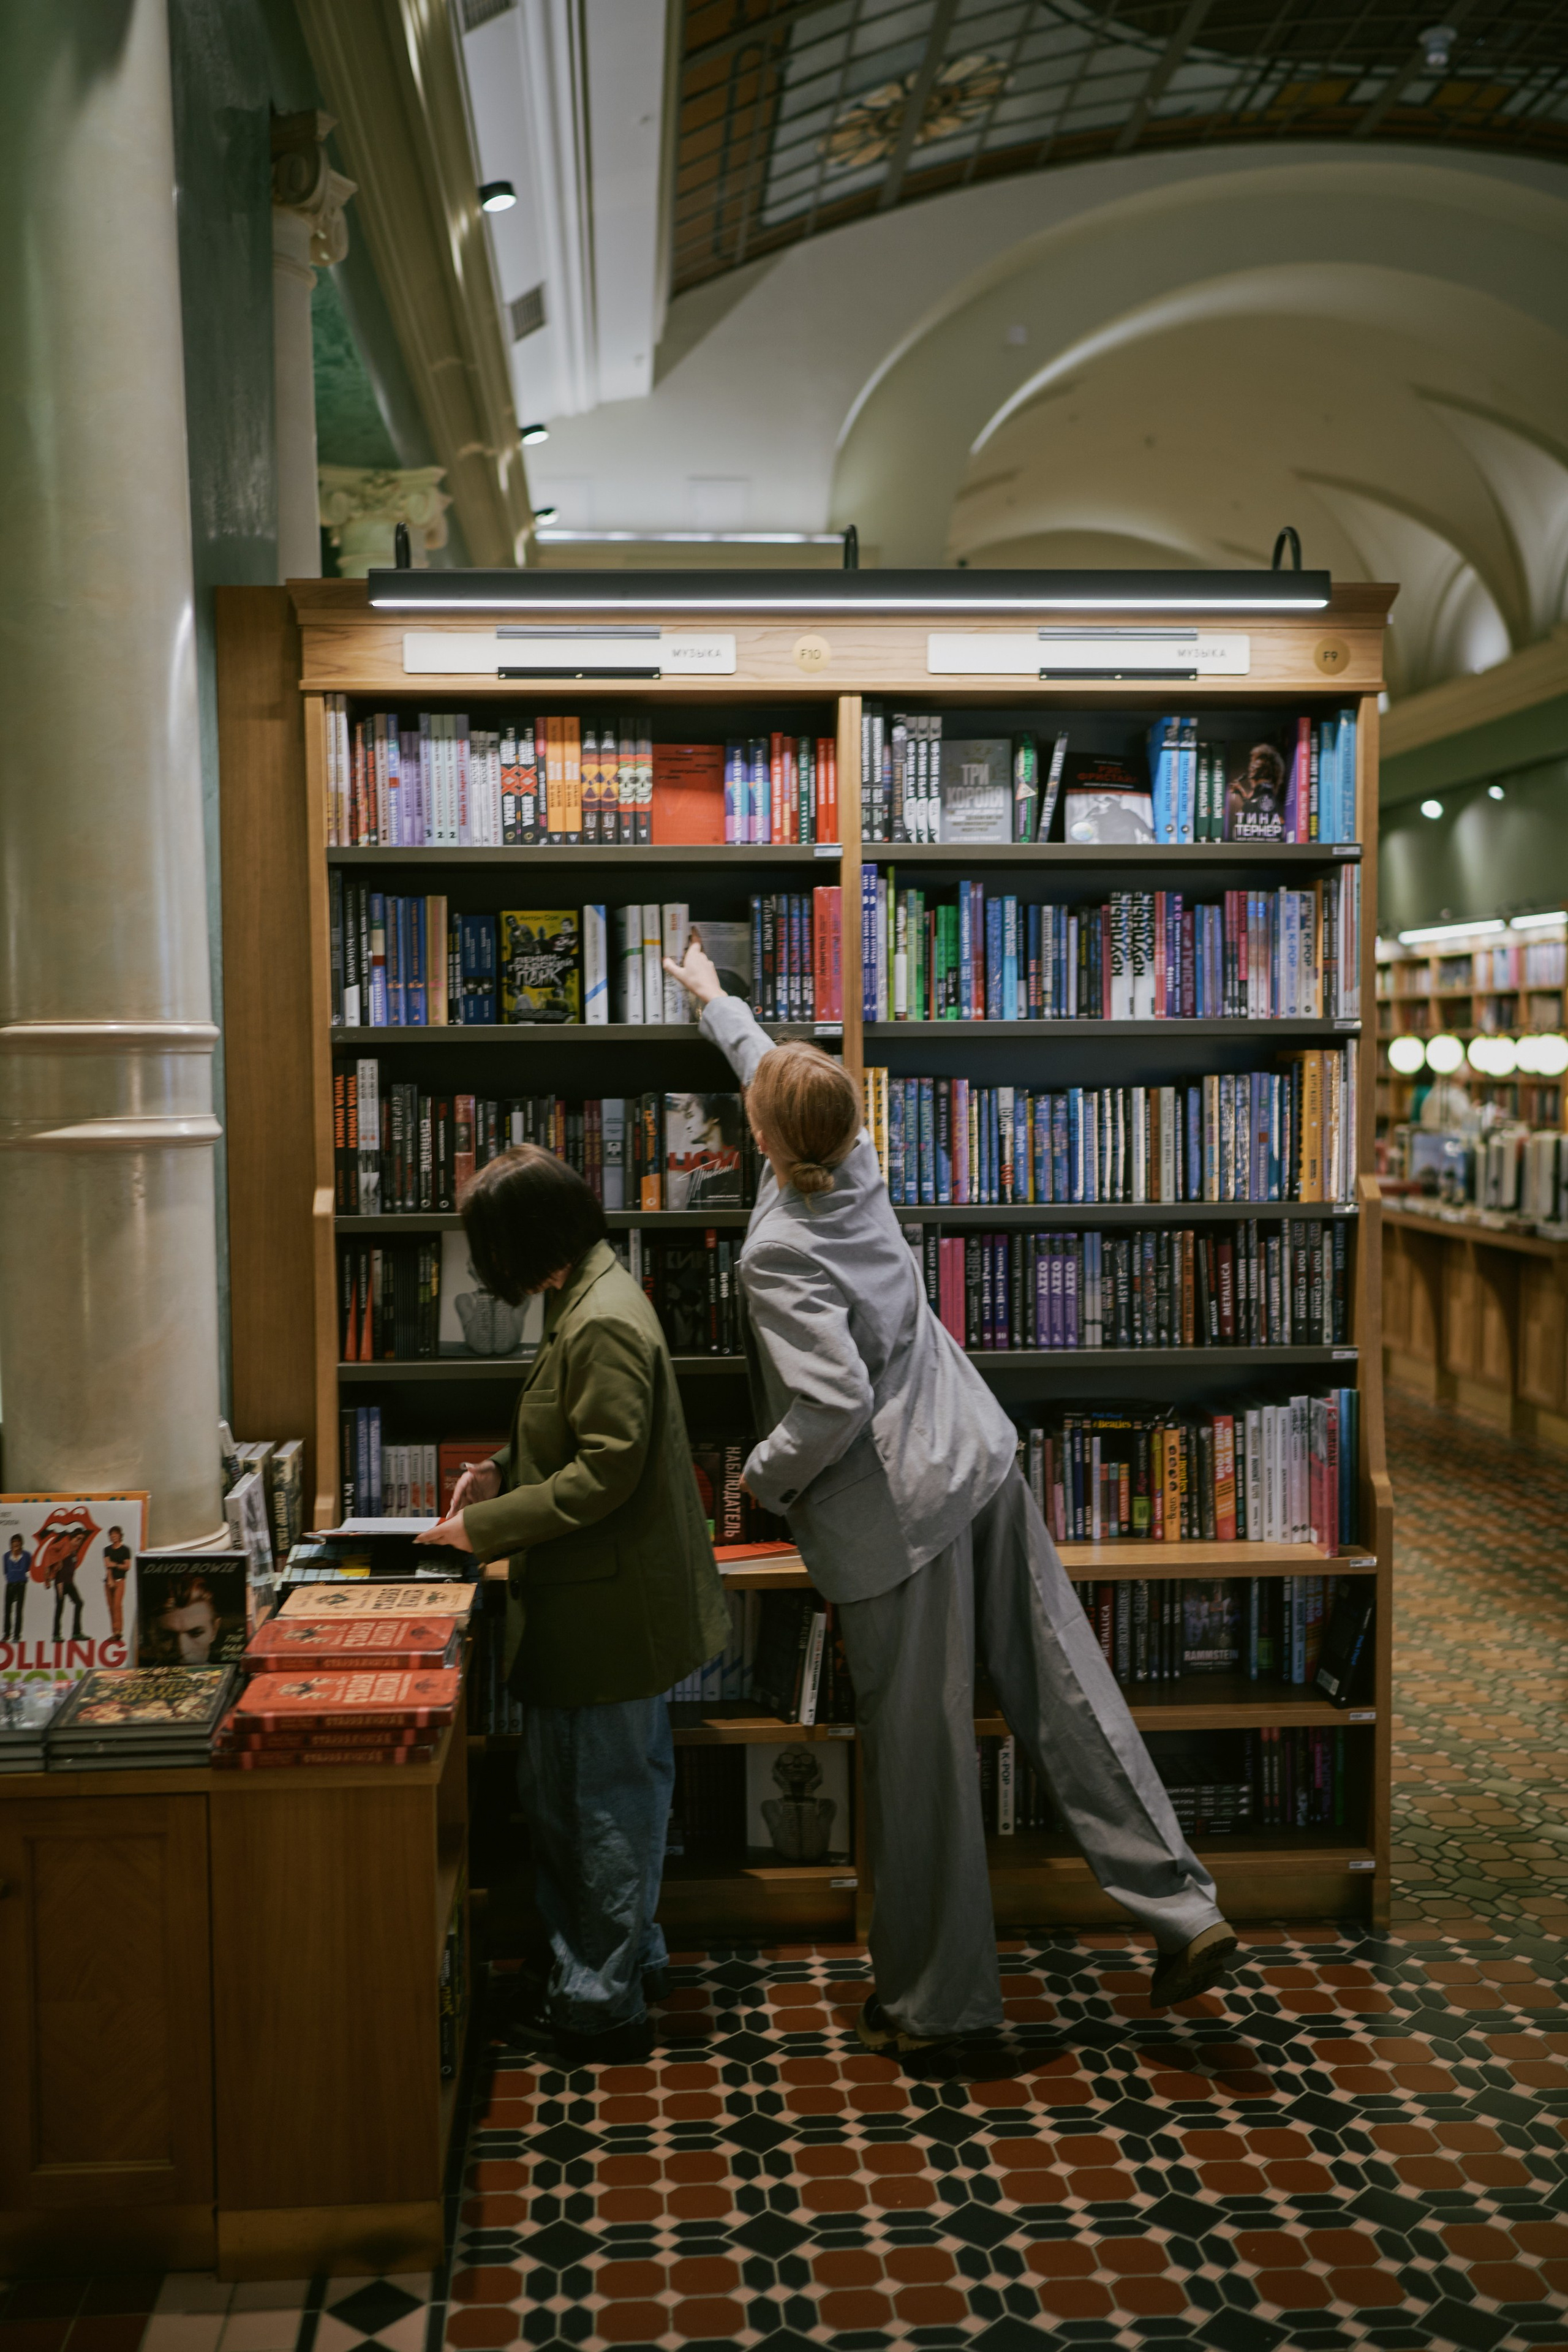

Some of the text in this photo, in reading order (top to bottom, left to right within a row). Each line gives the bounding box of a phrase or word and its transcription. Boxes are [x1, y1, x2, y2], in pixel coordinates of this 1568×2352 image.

[671, 647, 723, 659] МУЗЫКА
[799, 648, 821, 661] F10
[1177, 647, 1227, 659] МУЗЫКА
[1322, 650, 1338, 663] F9
[907, 741, 915, 796] WU-TANG CLAN
[918, 741, 927, 796] WU-TANG CLAN
[930, 741, 939, 796] WU-TANG CLAN
[961, 764, 989, 785] ТРИ
[1050, 752, 1064, 777] KIZARU
[946, 786, 1005, 809] КОРОЛЯ
[1199, 782, 1207, 817] ИСТОРИЯ
[1213, 783, 1222, 818] ИСТОРИЯ
[1234, 824, 1282, 837] ТЕРНЕР
[1235, 812, 1281, 825] ТИНА
[1174, 895, 1182, 920] EXO
[763, 900, 772, 950] АГАТА КРИСТИ
[1111, 892, 1123, 976] КРУПНЫЕ
[1123, 892, 1133, 962] ФОРМЫ
[1133, 892, 1144, 976] КРУПНЫЕ
[1143, 892, 1155, 962] ФОРМЫ
[508, 958, 573, 972] ГРАДСКИЙ
[514, 954, 560, 965] ЛЕНИН-
[1287, 933, 1296, 967] K-POP
[1183, 949, 1193, 990] TWICE
[334, 1074, 345, 1107] ТИПА
[347, 1074, 357, 1107] ТИПА
[391, 1097, 404, 1140] ЕГОР ЛЕТОВ
[1000, 1164, 1014, 1185] 100
[927, 1270, 937, 1298] ДОЛТРИ
[966, 1250, 981, 1286] ЗВЕРЬ
[1038, 1261, 1049, 1295] OZZY
[1051, 1261, 1062, 1295] OZZY
[1065, 1261, 1076, 1295] OZZY
[1237, 1259, 1246, 1299] RAMMSTEIN
[1297, 1251, 1306, 1319] ПОЛ СТЭНЛИ
[1117, 1272, 1129, 1303] SLASH
[1223, 1262, 1232, 1316] METALLICA
[1210, 1300, 1218, 1335] METALLICA
[1215, 1421, 1224, 1479] THREE FOUR
[1328, 1429, 1337, 1467] NIRVANA
[1251, 1458, 1260, 1482] ДЖОНОМ
[722, 1447, 742, 1537] НАБЛЮДАТЕЛЬ
[276, 1528, 290, 1550] ГАЗА
[143, 1562, 239, 1574] DAVID BOWIE
[1101, 1605, 1111, 1657] METALLICA
[0, 1639, 127, 1670] OLLING
[1183, 1649, 1239, 1660] RAMMSTEIN
